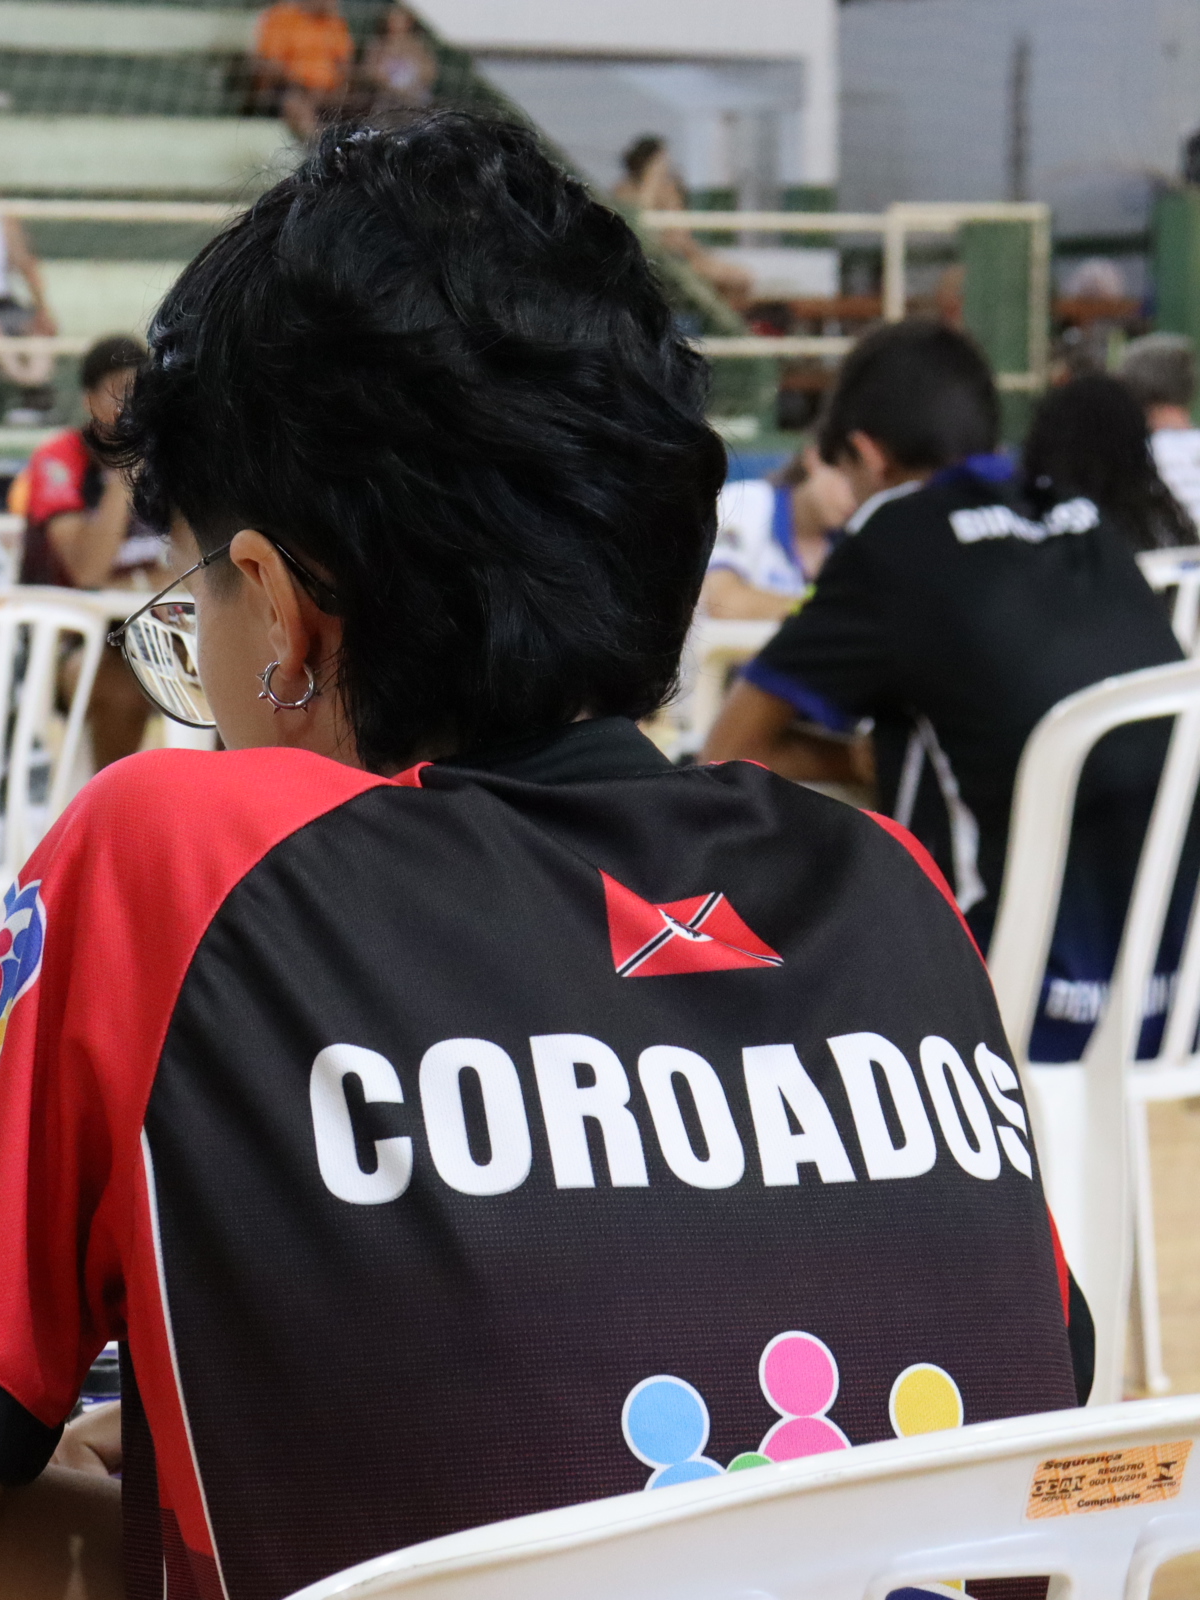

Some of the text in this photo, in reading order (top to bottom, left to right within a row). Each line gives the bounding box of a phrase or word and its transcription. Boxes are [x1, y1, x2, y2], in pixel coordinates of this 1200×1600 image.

[309, 1031, 1034, 1205] COROADOS
[1043, 1453, 1123, 1471] Segurança
[1097, 1462, 1145, 1476] REGISTRO
[1077, 1492, 1141, 1508] Compulsório
